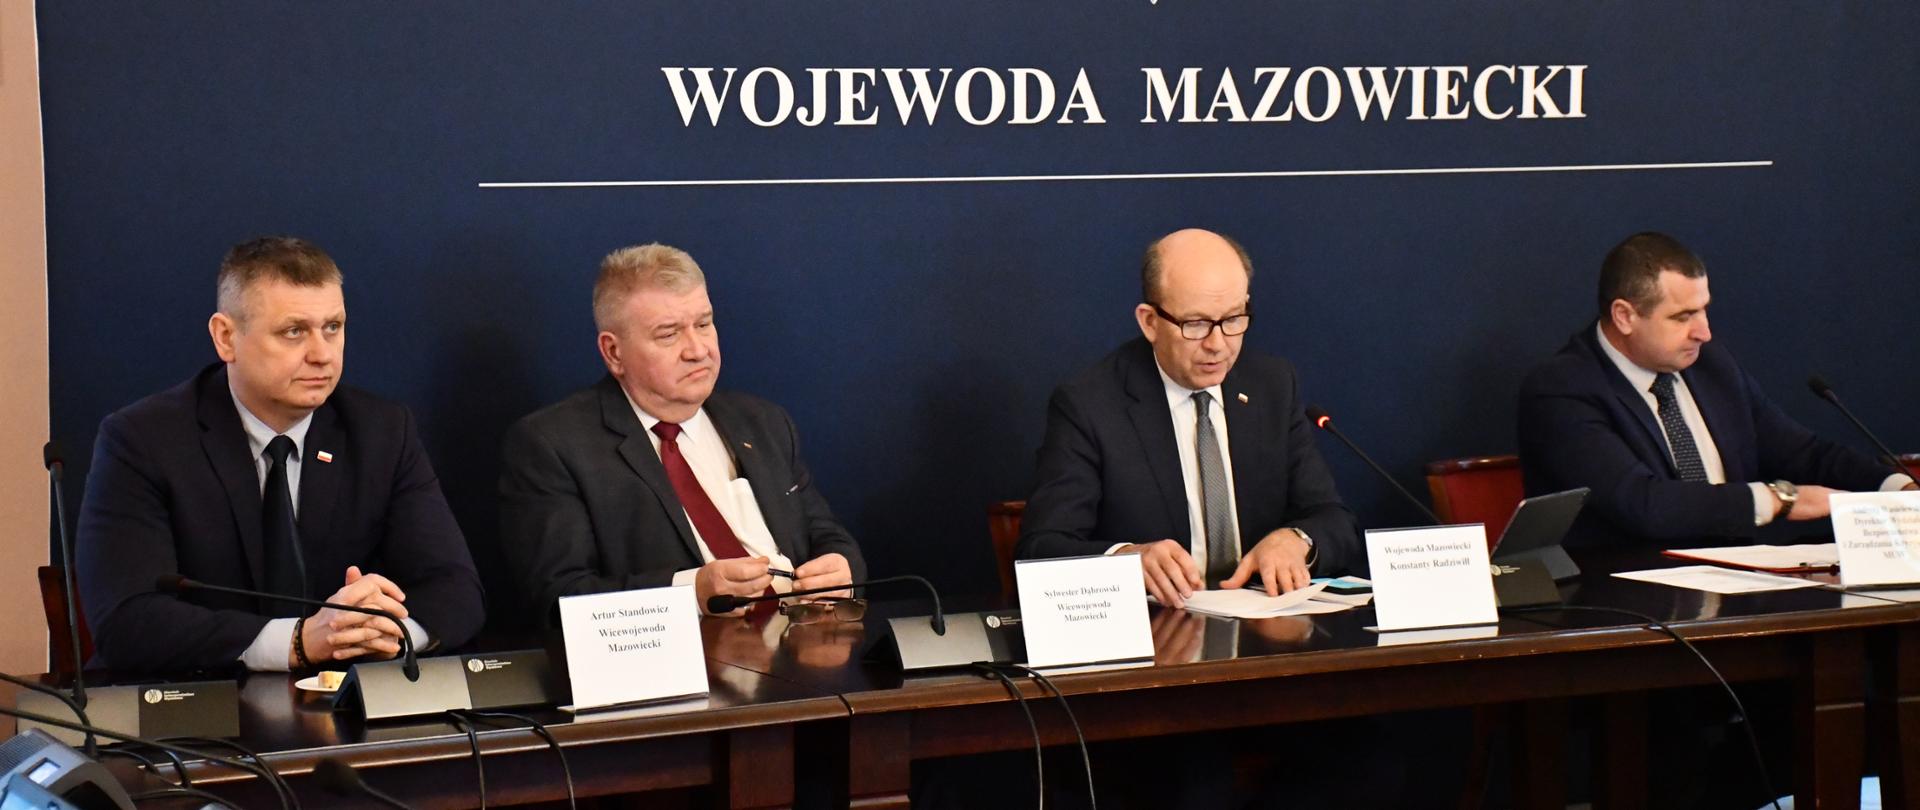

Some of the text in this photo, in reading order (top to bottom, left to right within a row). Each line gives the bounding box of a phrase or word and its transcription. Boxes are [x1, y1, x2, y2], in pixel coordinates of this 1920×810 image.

[660, 64, 1588, 127] WOJEWODA MAZOWIECKI
[1384, 541, 1472, 555] Wojewoda Mazowiecki
[1390, 560, 1430, 570] Konstanty
[1044, 584, 1120, 598] Sylwester Dąbrowski
[1057, 600, 1112, 611] Wicewojewoda
[591, 605, 669, 621] Artur Standowicz
[1064, 611, 1107, 622] Mazowiecki
[599, 623, 666, 638] Wicewojewoda
[608, 639, 662, 653] Mazowiecki
